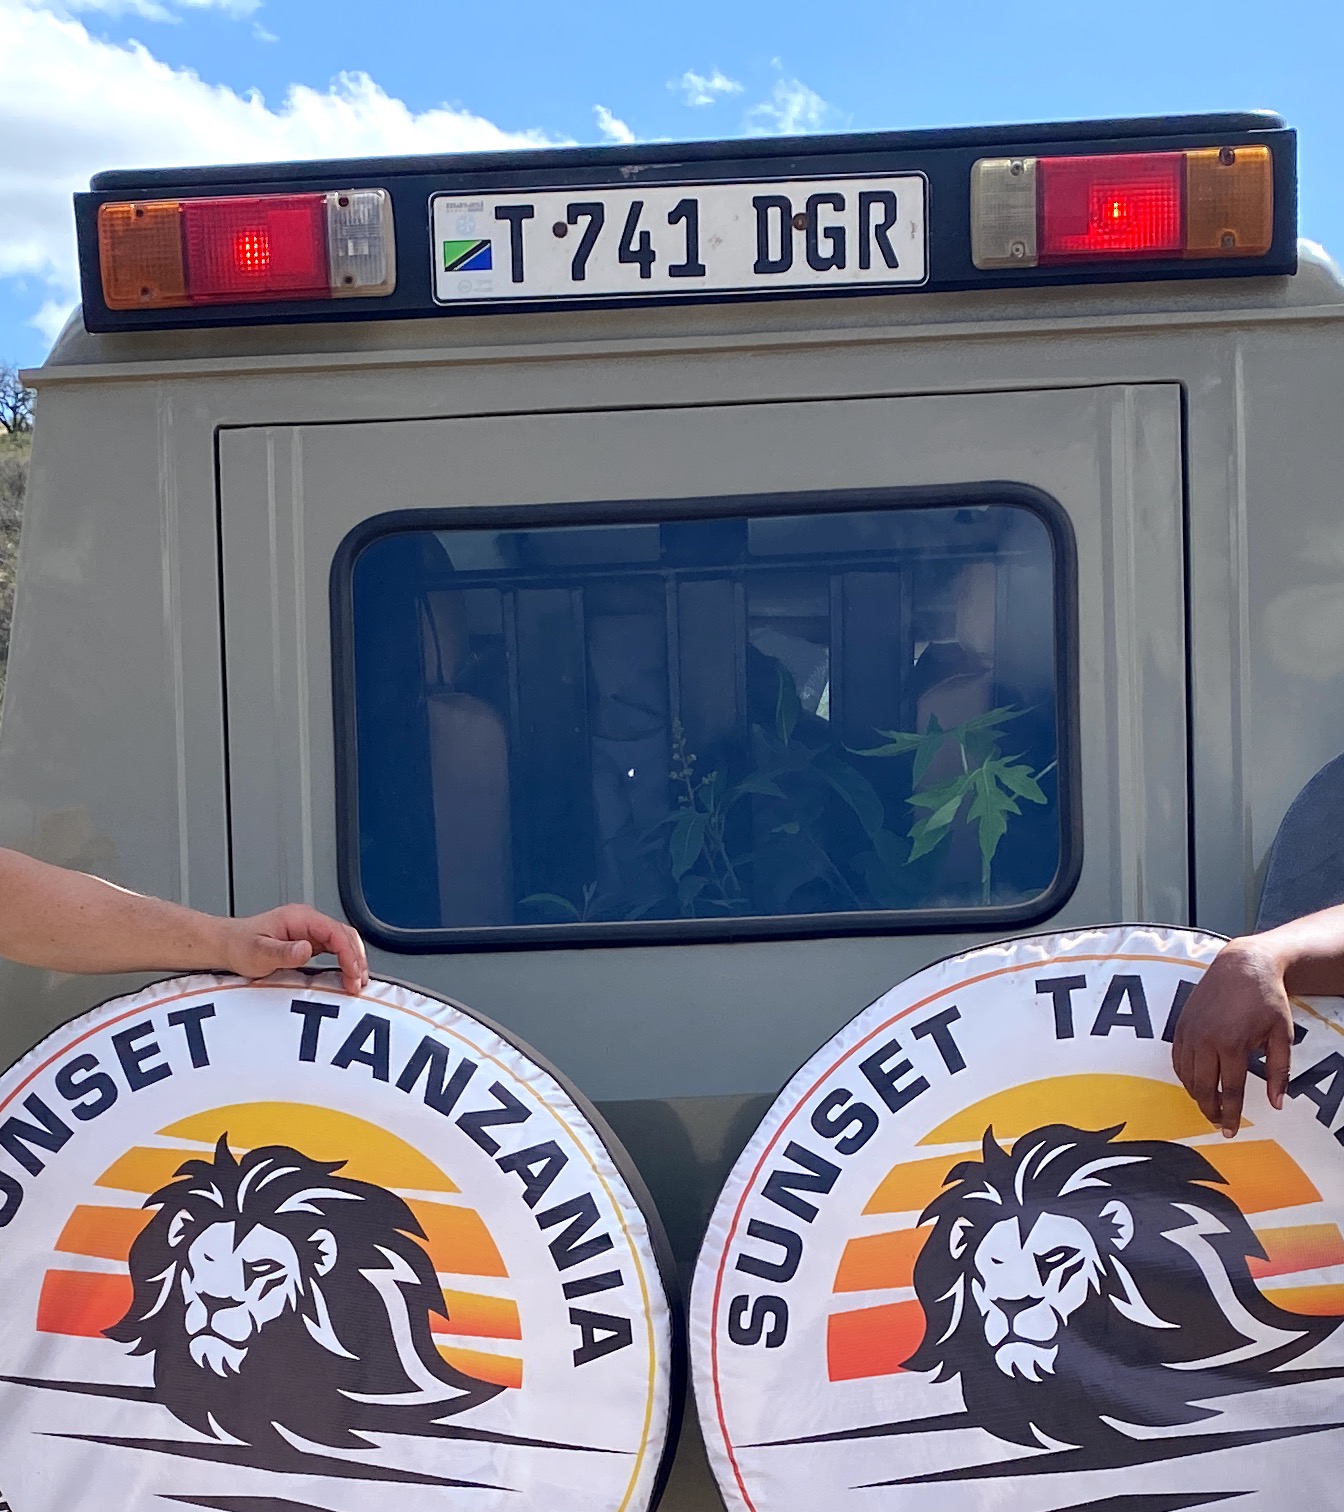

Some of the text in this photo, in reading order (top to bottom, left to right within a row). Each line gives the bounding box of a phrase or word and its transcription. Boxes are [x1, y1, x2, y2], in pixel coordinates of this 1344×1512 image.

[495, 190, 900, 283] T 741 DGR
[289, 999, 634, 1368] TANZANIA
[728, 1005, 968, 1350] SUNSET
